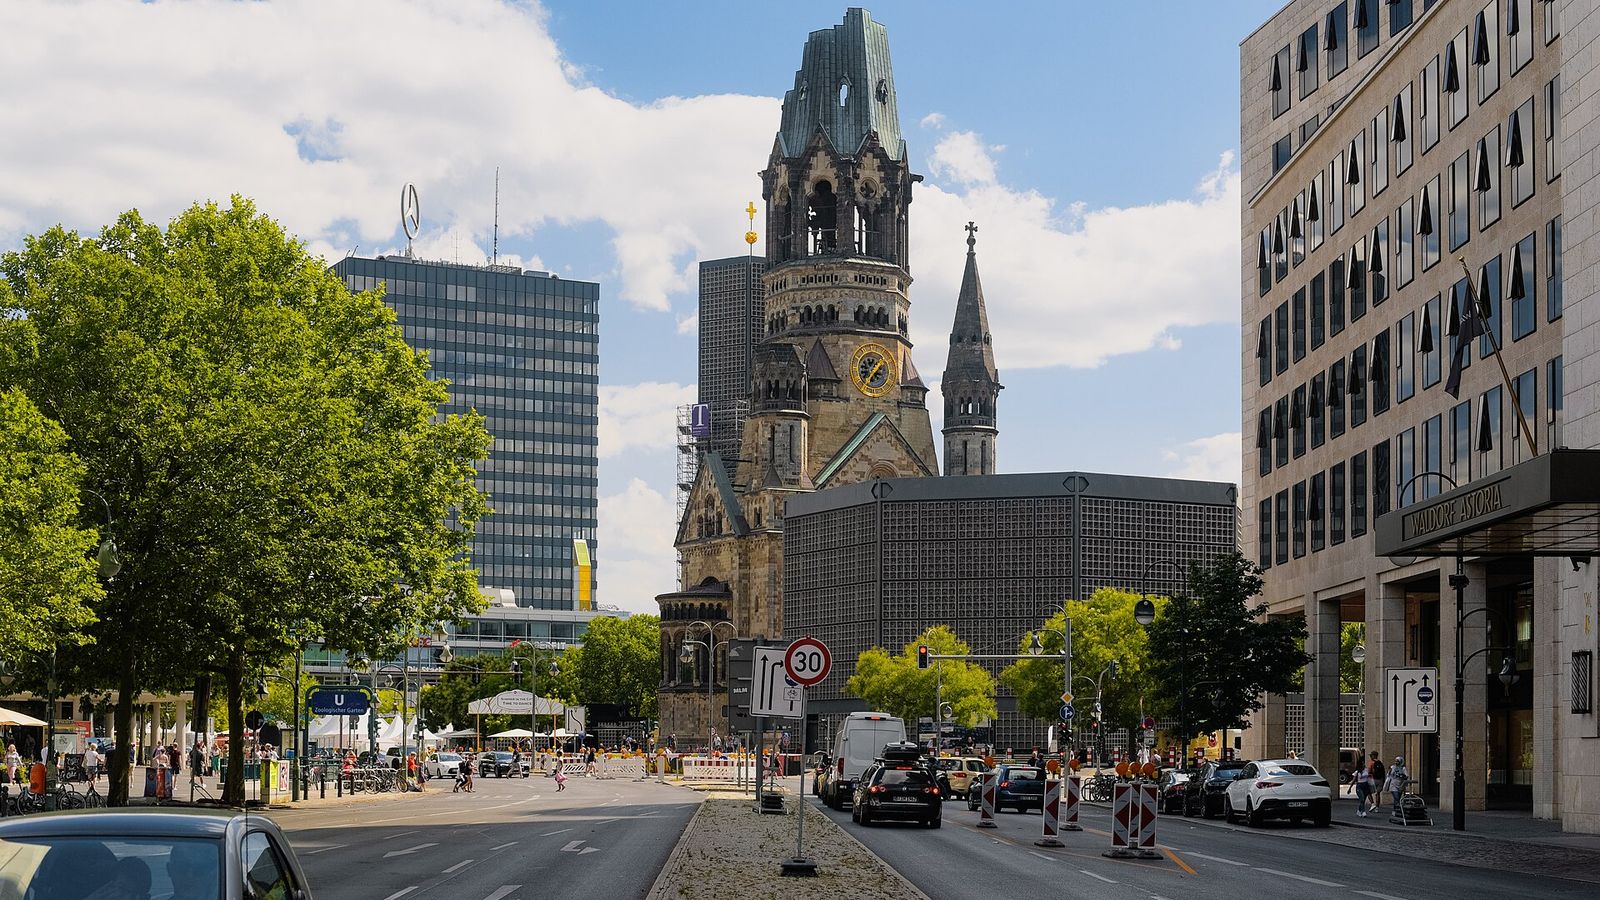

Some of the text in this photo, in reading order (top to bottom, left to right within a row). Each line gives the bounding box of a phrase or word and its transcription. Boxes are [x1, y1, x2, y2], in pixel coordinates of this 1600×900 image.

[693, 404, 708, 426] T
[1411, 484, 1503, 536] WALDORF ASTORIA
[795, 651, 821, 672] 30
[334, 694, 344, 706] U
